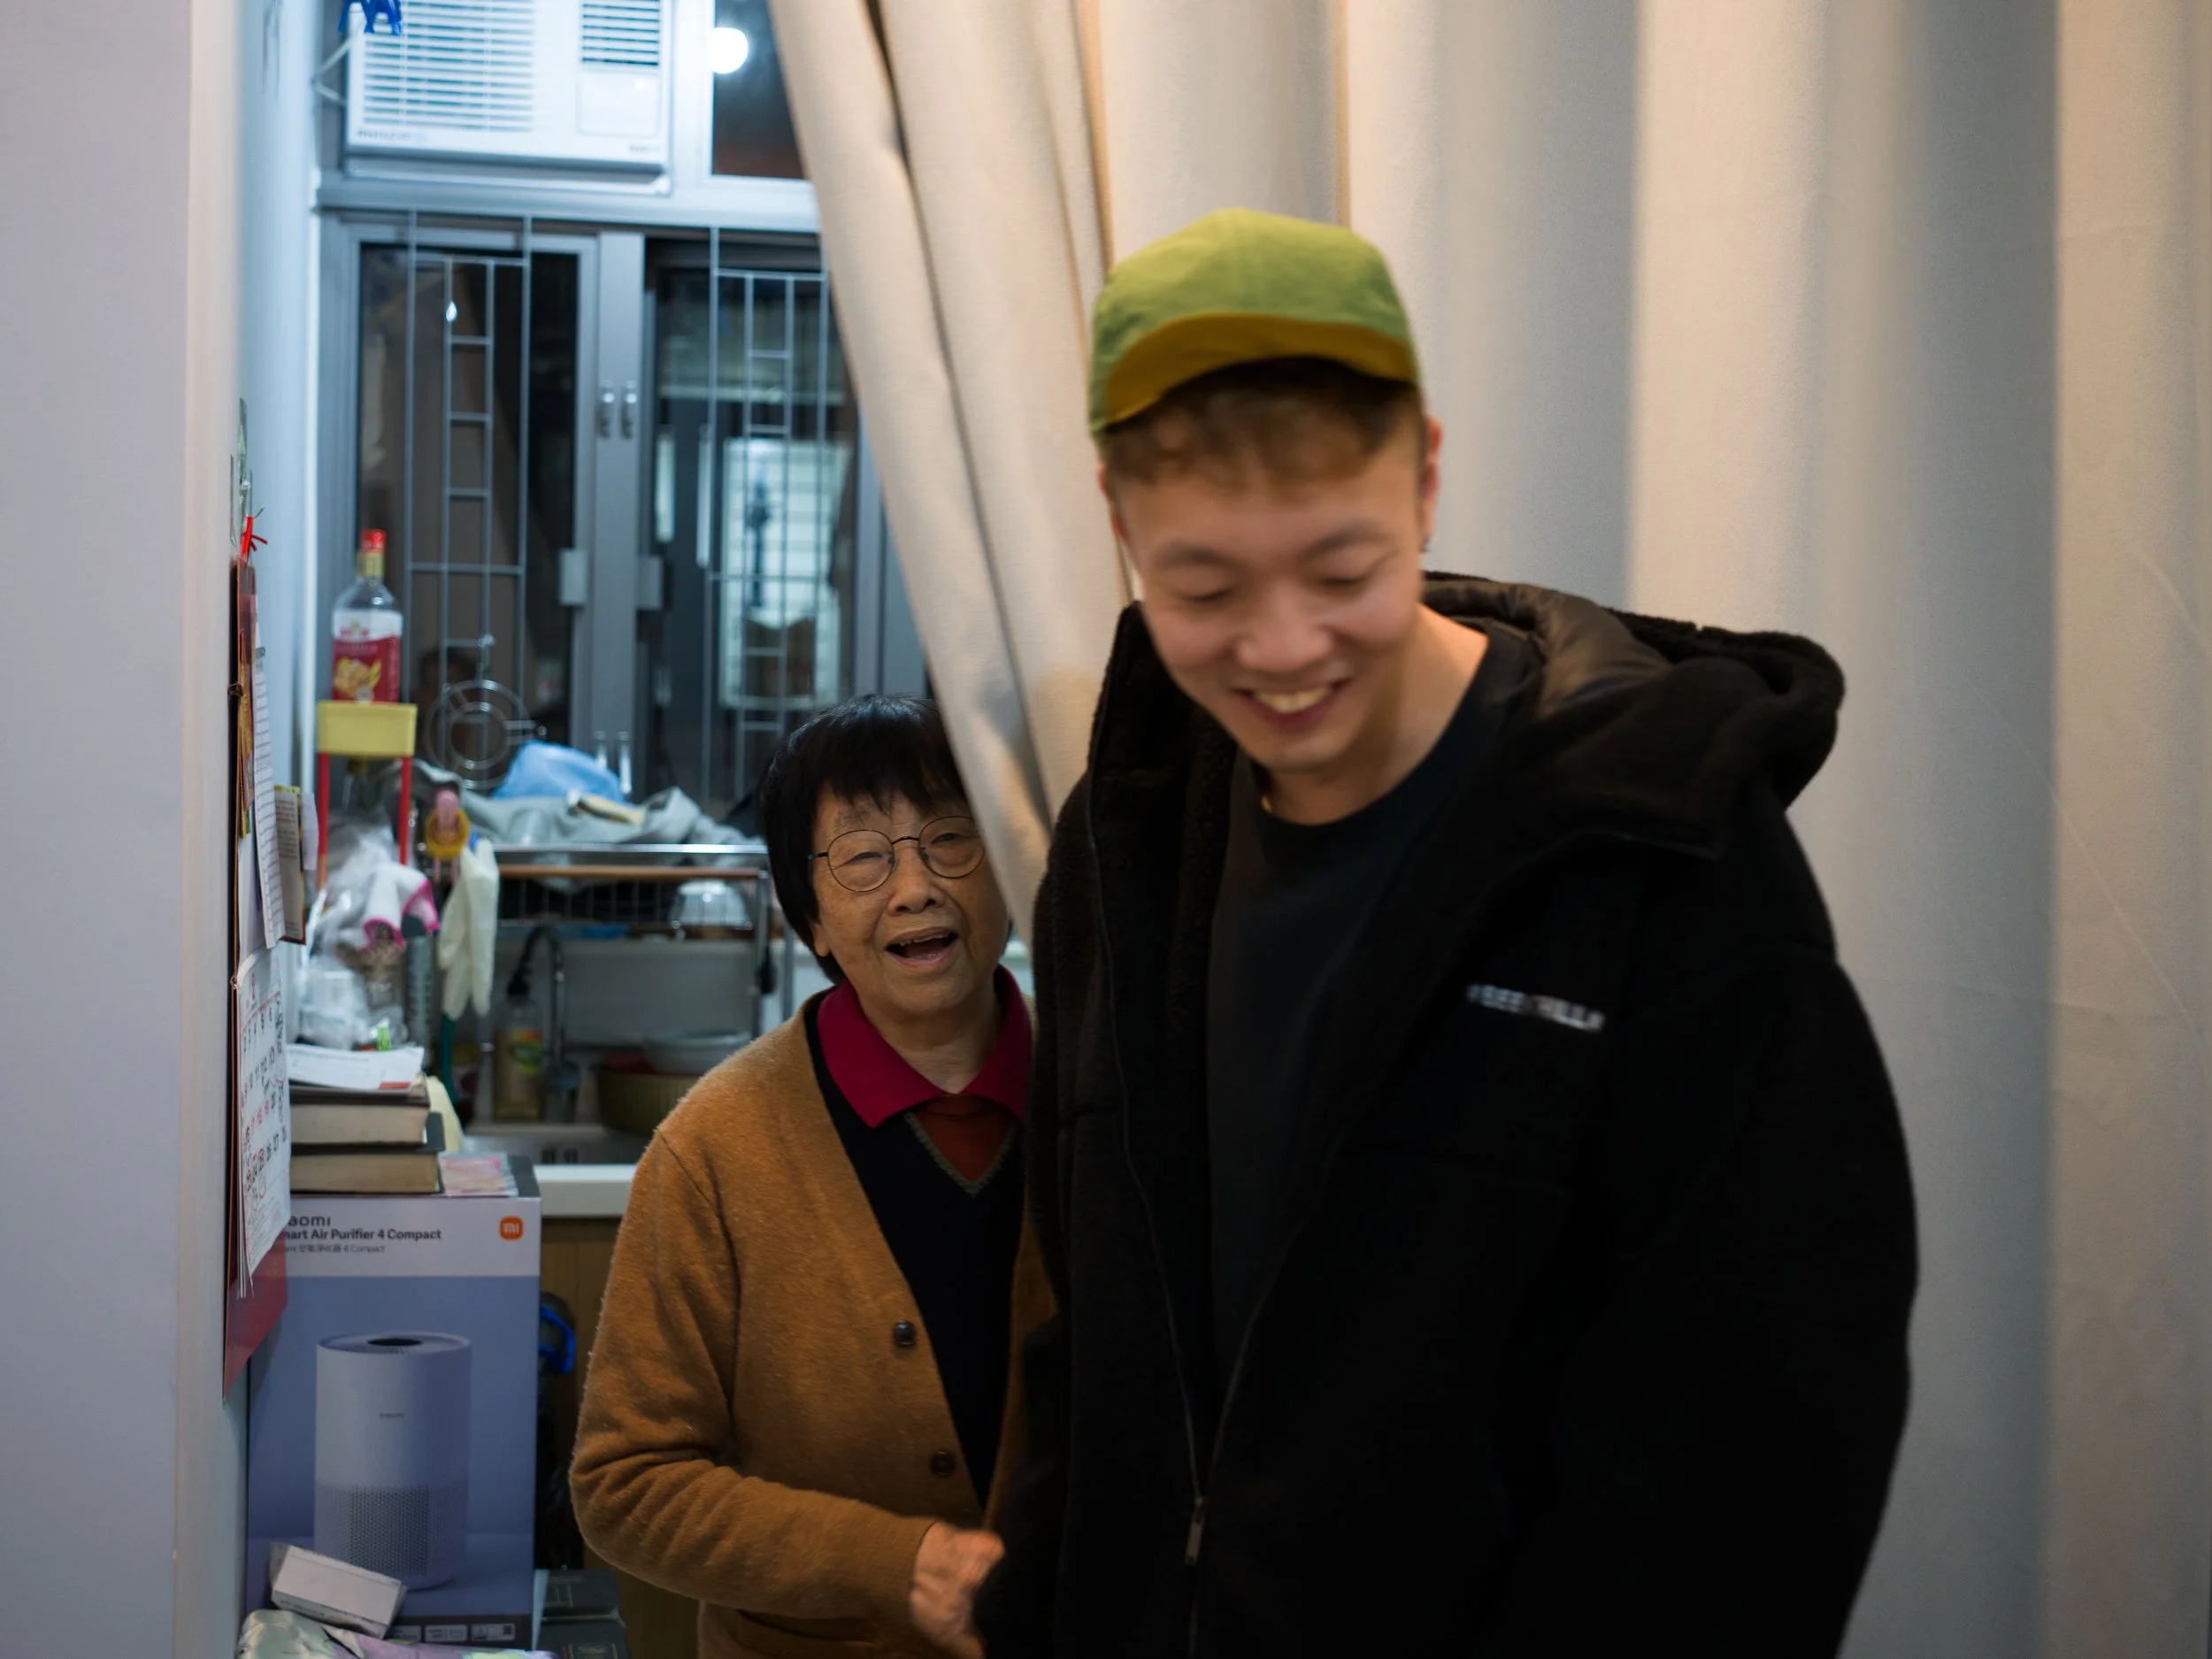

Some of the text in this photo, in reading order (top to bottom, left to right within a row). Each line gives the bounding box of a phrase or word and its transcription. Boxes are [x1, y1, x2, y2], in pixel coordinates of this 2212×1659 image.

[288, 1216, 331, 1227] aomi
[285, 1228, 442, 1242] mart Air Purifier 4 Compact
[350, 1244, 386, 1254] Compact
